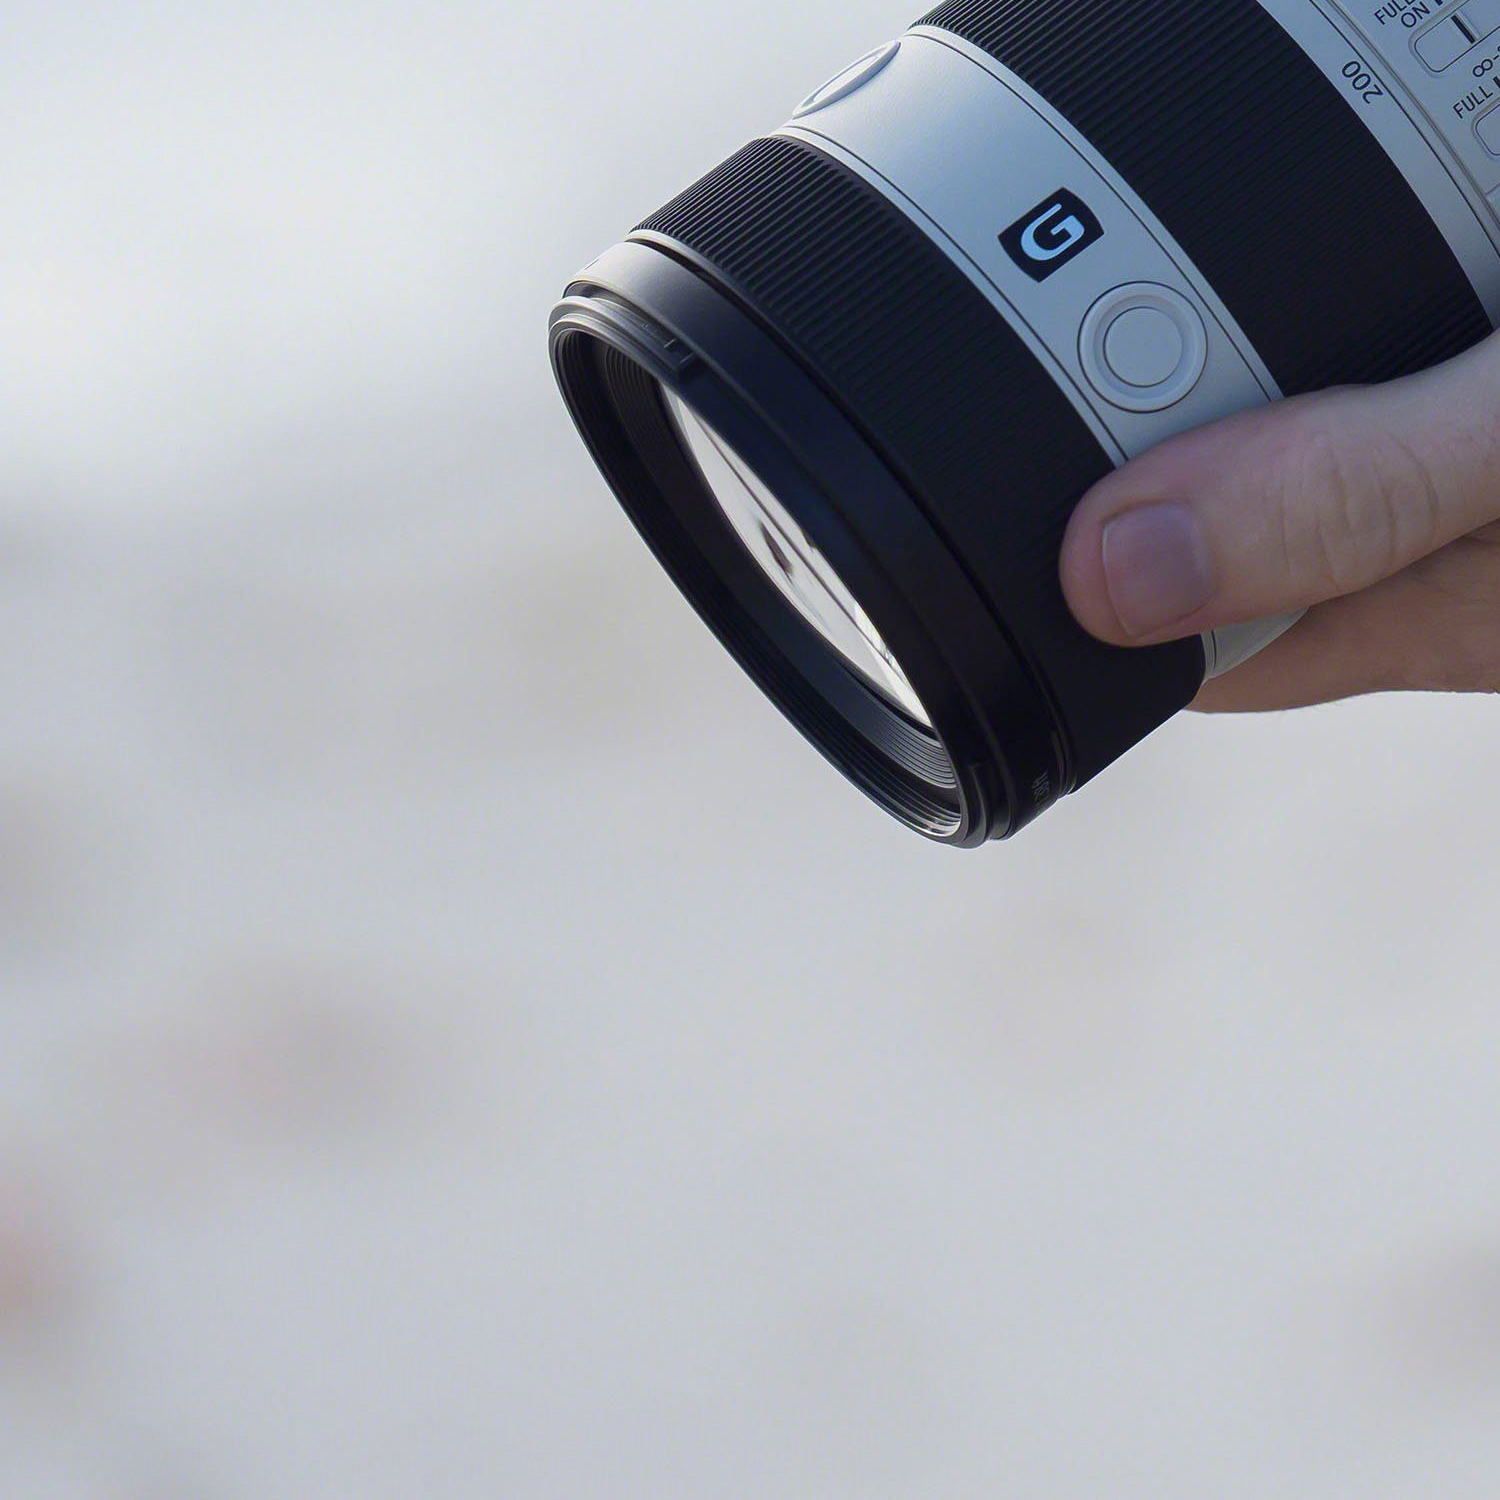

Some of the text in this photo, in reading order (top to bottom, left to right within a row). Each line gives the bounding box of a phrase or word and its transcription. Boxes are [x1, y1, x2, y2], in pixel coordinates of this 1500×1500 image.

[1400, 2, 1432, 29] ON
[1341, 60, 1384, 105] 200
[1452, 85, 1494, 120] FULL
[1020, 203, 1086, 261] G
